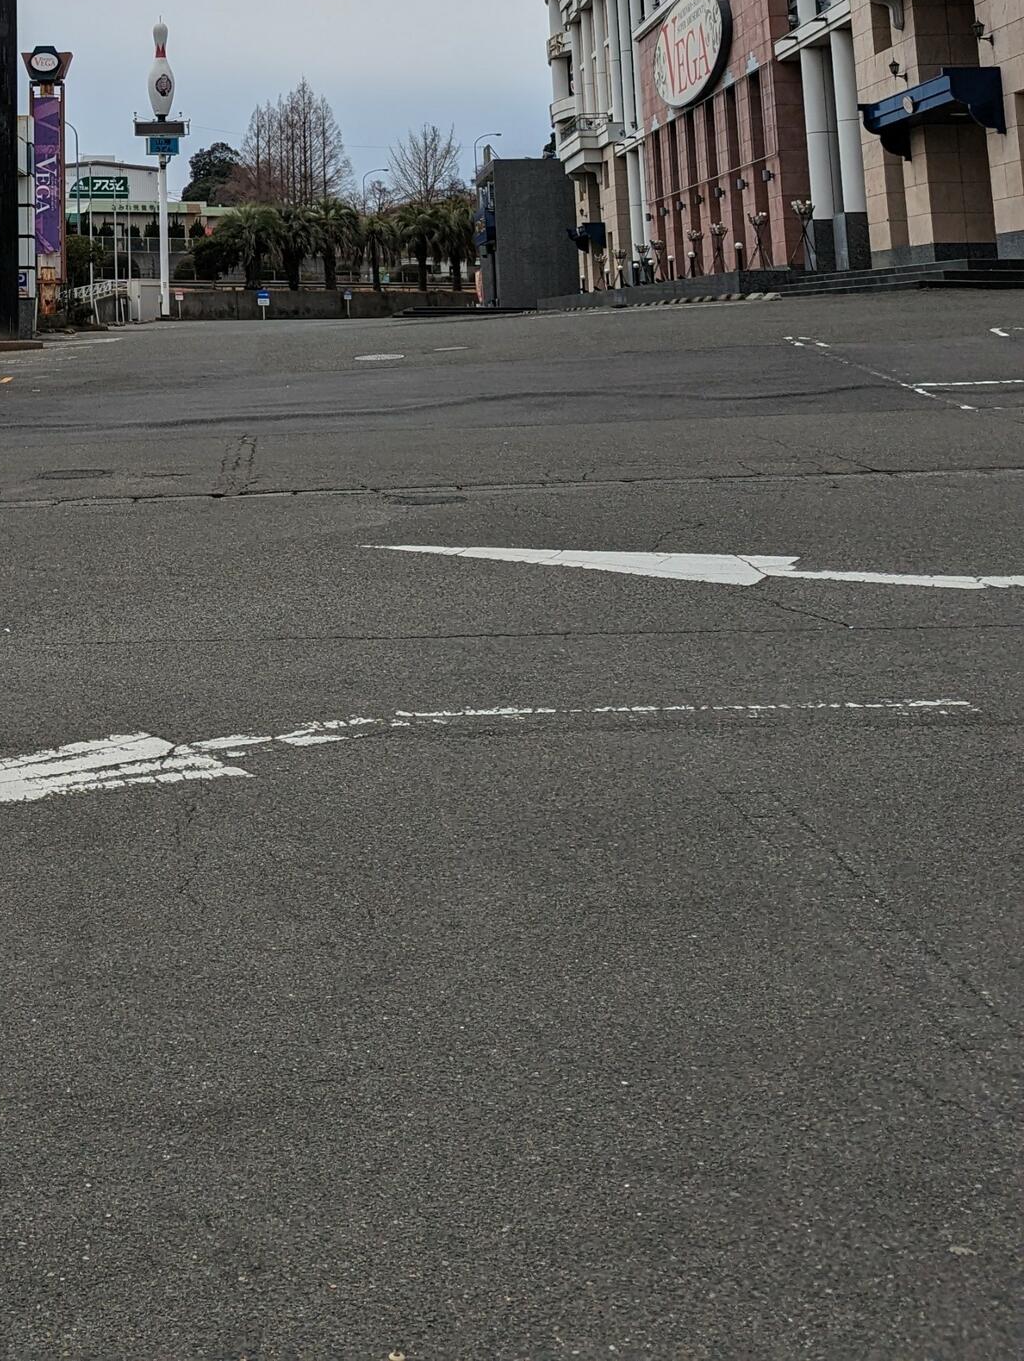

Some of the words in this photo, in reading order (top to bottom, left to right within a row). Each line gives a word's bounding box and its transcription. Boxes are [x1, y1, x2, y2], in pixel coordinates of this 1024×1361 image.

[34, 56, 56, 67] VEGA
[660, 15, 712, 97] VEGA
[35, 154, 57, 214] VEGA
